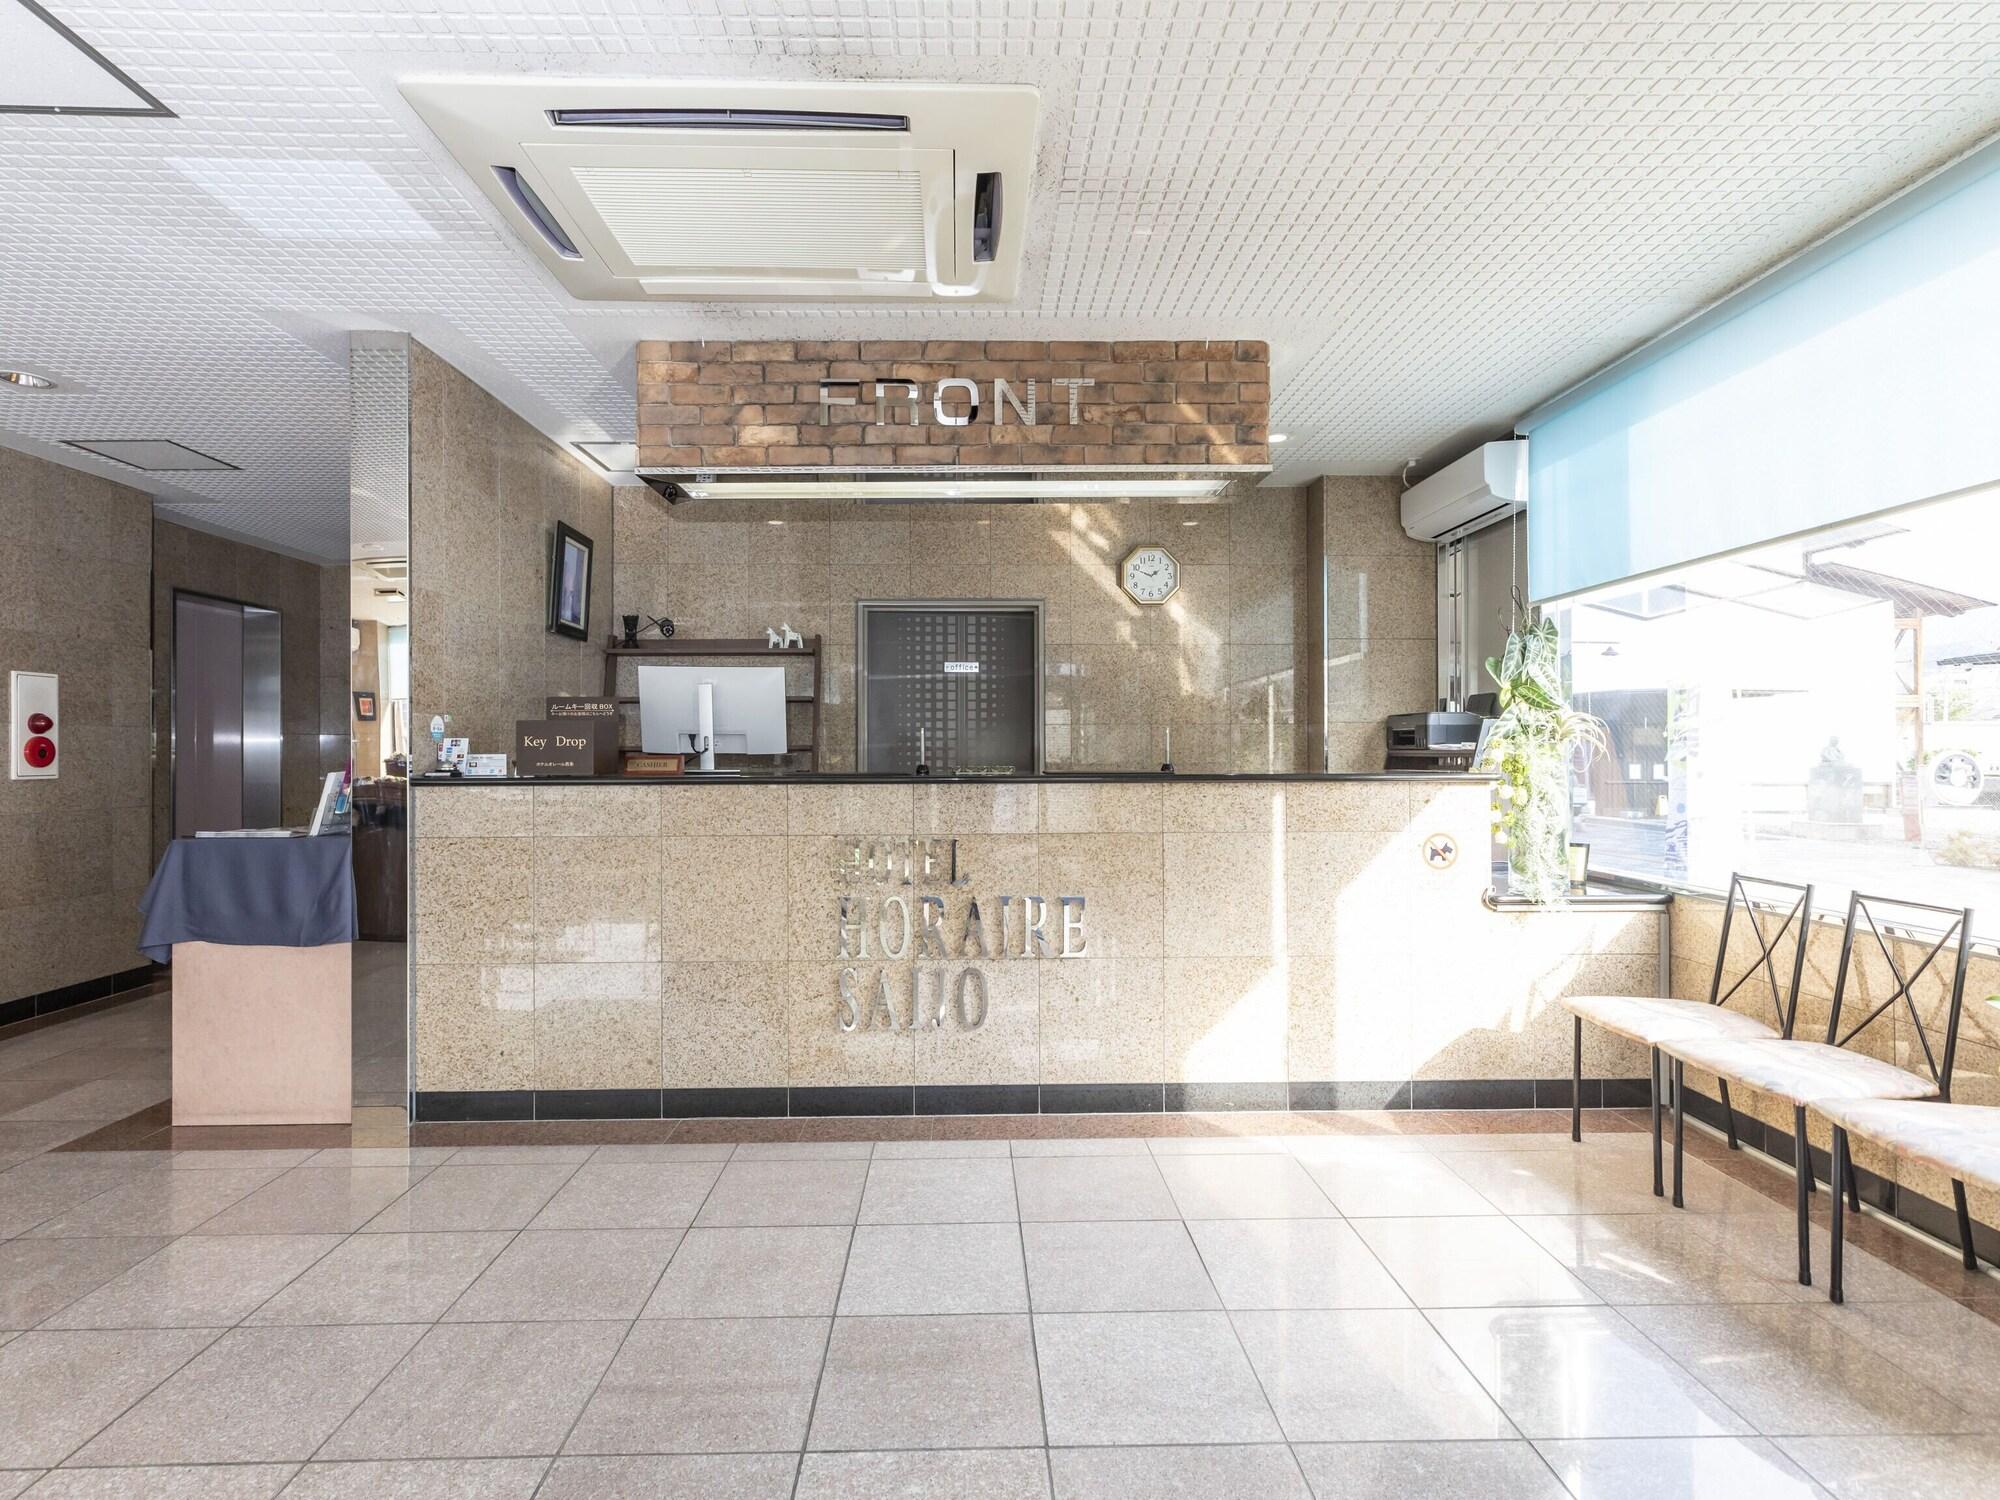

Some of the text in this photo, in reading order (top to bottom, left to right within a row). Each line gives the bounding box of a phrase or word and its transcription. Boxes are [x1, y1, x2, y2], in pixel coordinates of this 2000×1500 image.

[819, 377, 1096, 427] FRONT
[523, 735, 587, 750] Key Drop
[837, 896, 1088, 960] HORAIRE
[838, 966, 990, 1032] SAIJO
